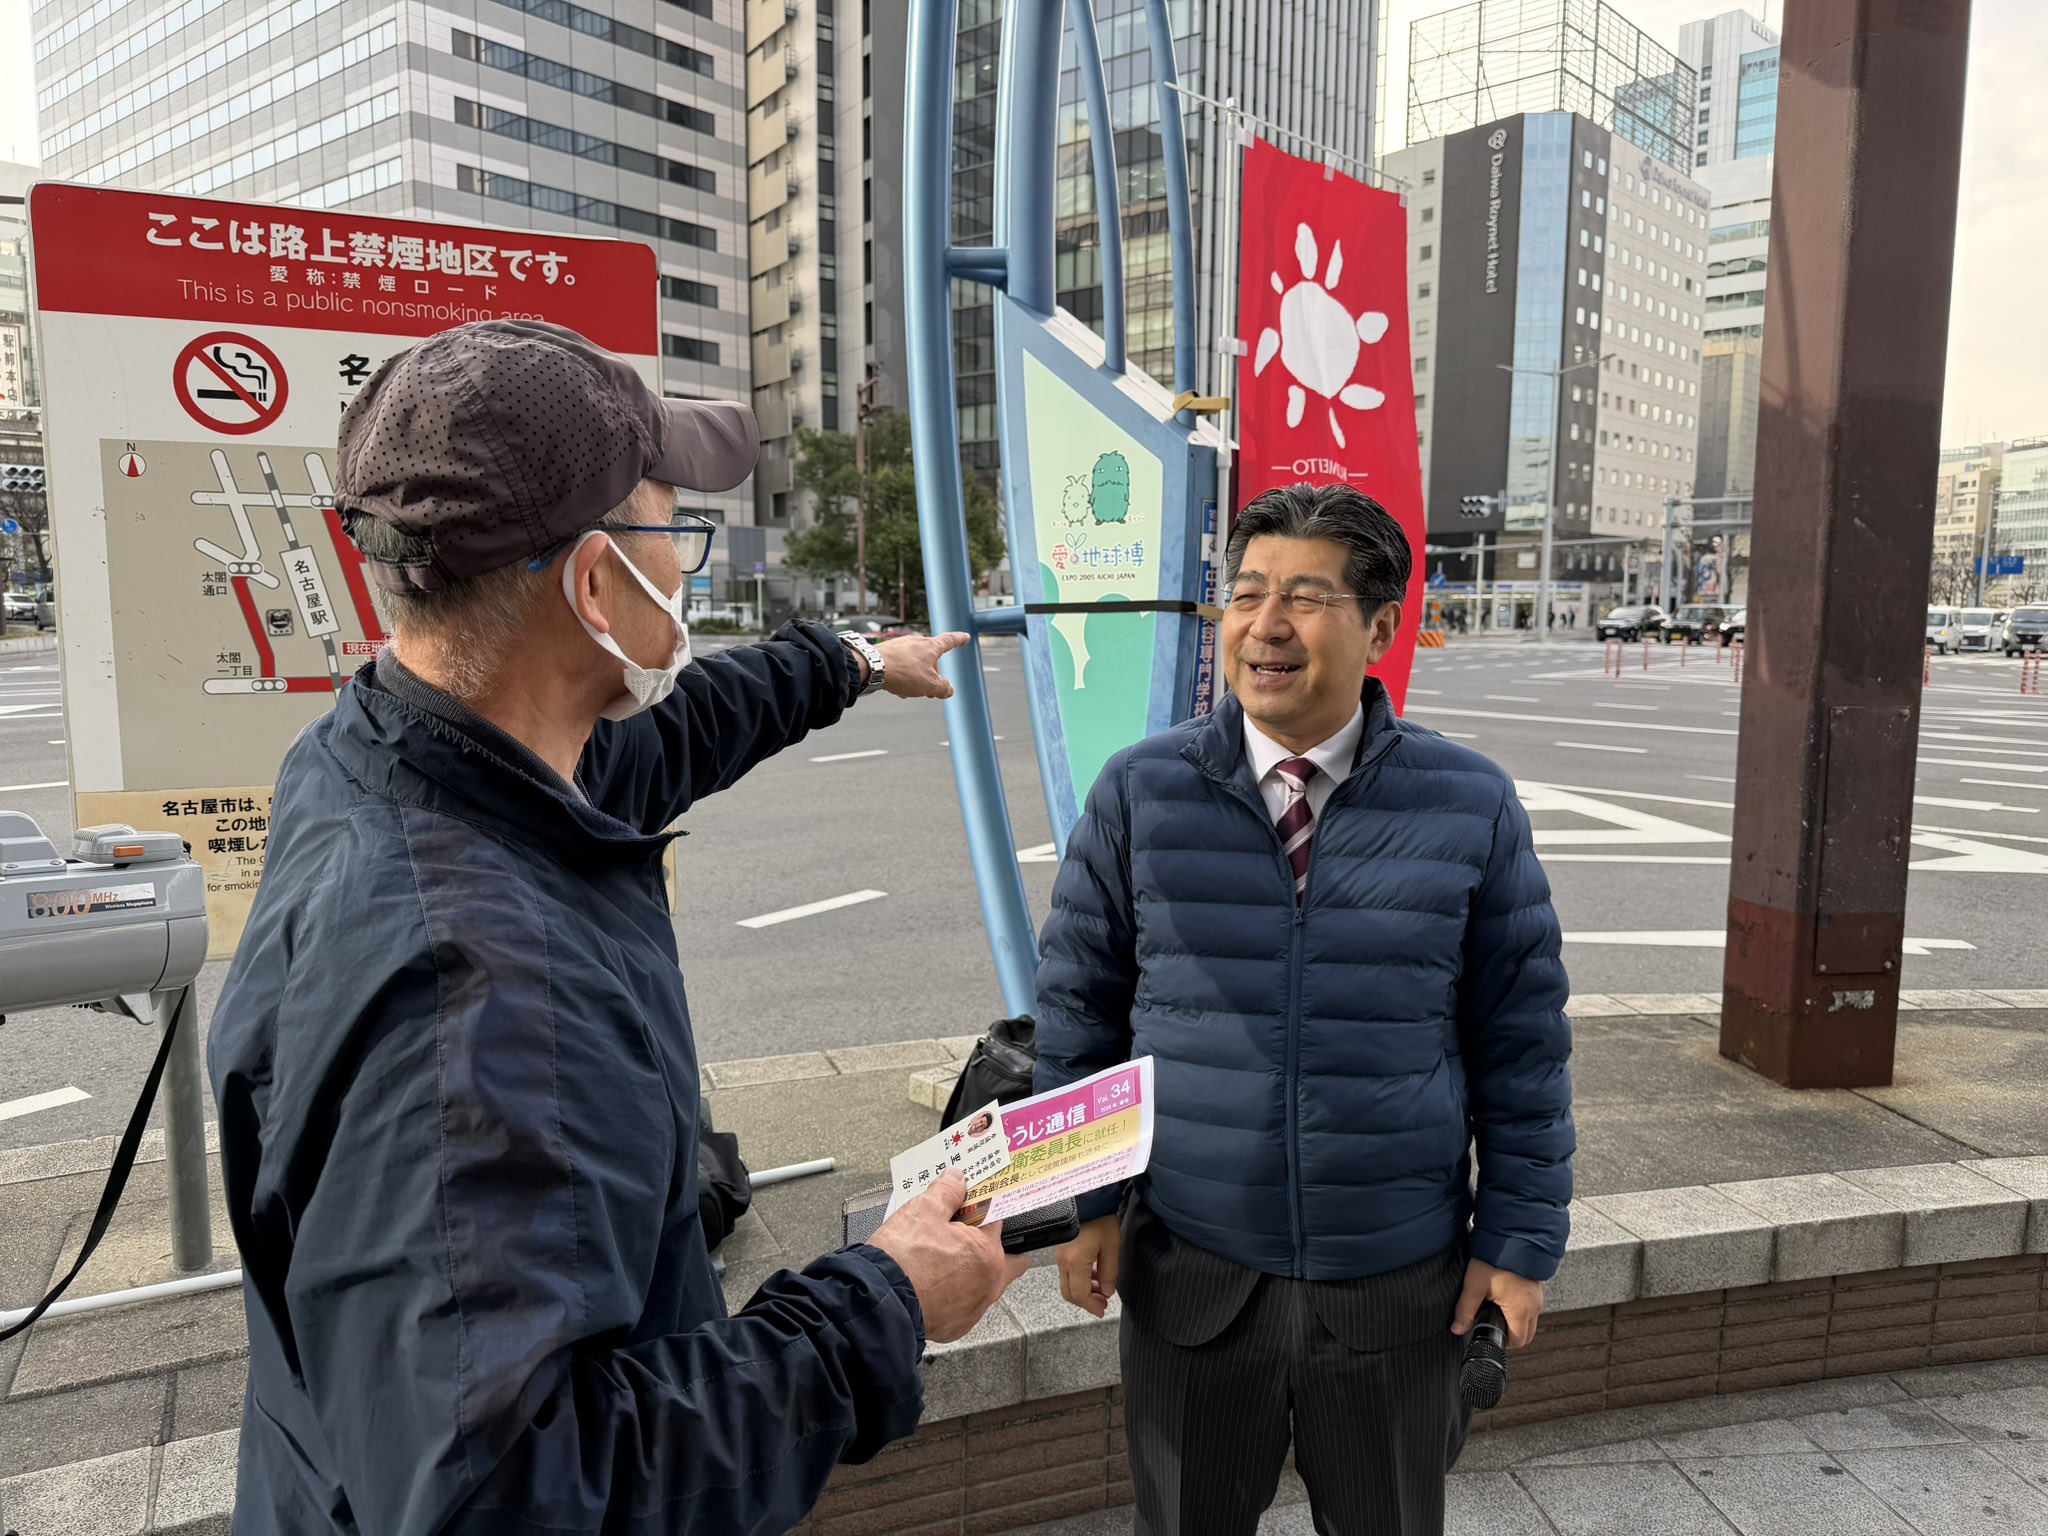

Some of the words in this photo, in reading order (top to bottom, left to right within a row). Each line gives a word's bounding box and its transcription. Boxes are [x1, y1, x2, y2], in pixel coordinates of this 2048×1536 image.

[1489, 152, 1504, 198] Daiwa
[1486, 198, 1502, 251] Roynet
[146, 211, 577, 286] ここは路上禁煙地区です。
[1485, 252, 1500, 294] Hotel
[176, 278, 228, 303] This
[236, 283, 255, 305] is
[263, 291, 277, 307] a
[286, 290, 354, 313] public
[362, 298, 493, 322] nonsmoking
[126, 442, 136, 451] N
[1082, 540, 1144, 568] 地球博
[202, 571, 227, 584] 太閤
[1117, 572, 1136, 580] JAPAN
[203, 585, 227, 597] 通口
[294, 559, 329, 626] 名古屋駅
[216, 652, 241, 664] 太閤
[217, 665, 252, 676] 一丁目
[162, 797, 272, 817] 名古屋市は、
[215, 816, 271, 832] この地
[236, 856, 256, 866] The
[241, 868, 250, 877] in
[207, 883, 222, 892] for
[30, 889, 92, 918] 800
[92, 891, 119, 903] MHz
[1110, 1079, 1132, 1099] 34
